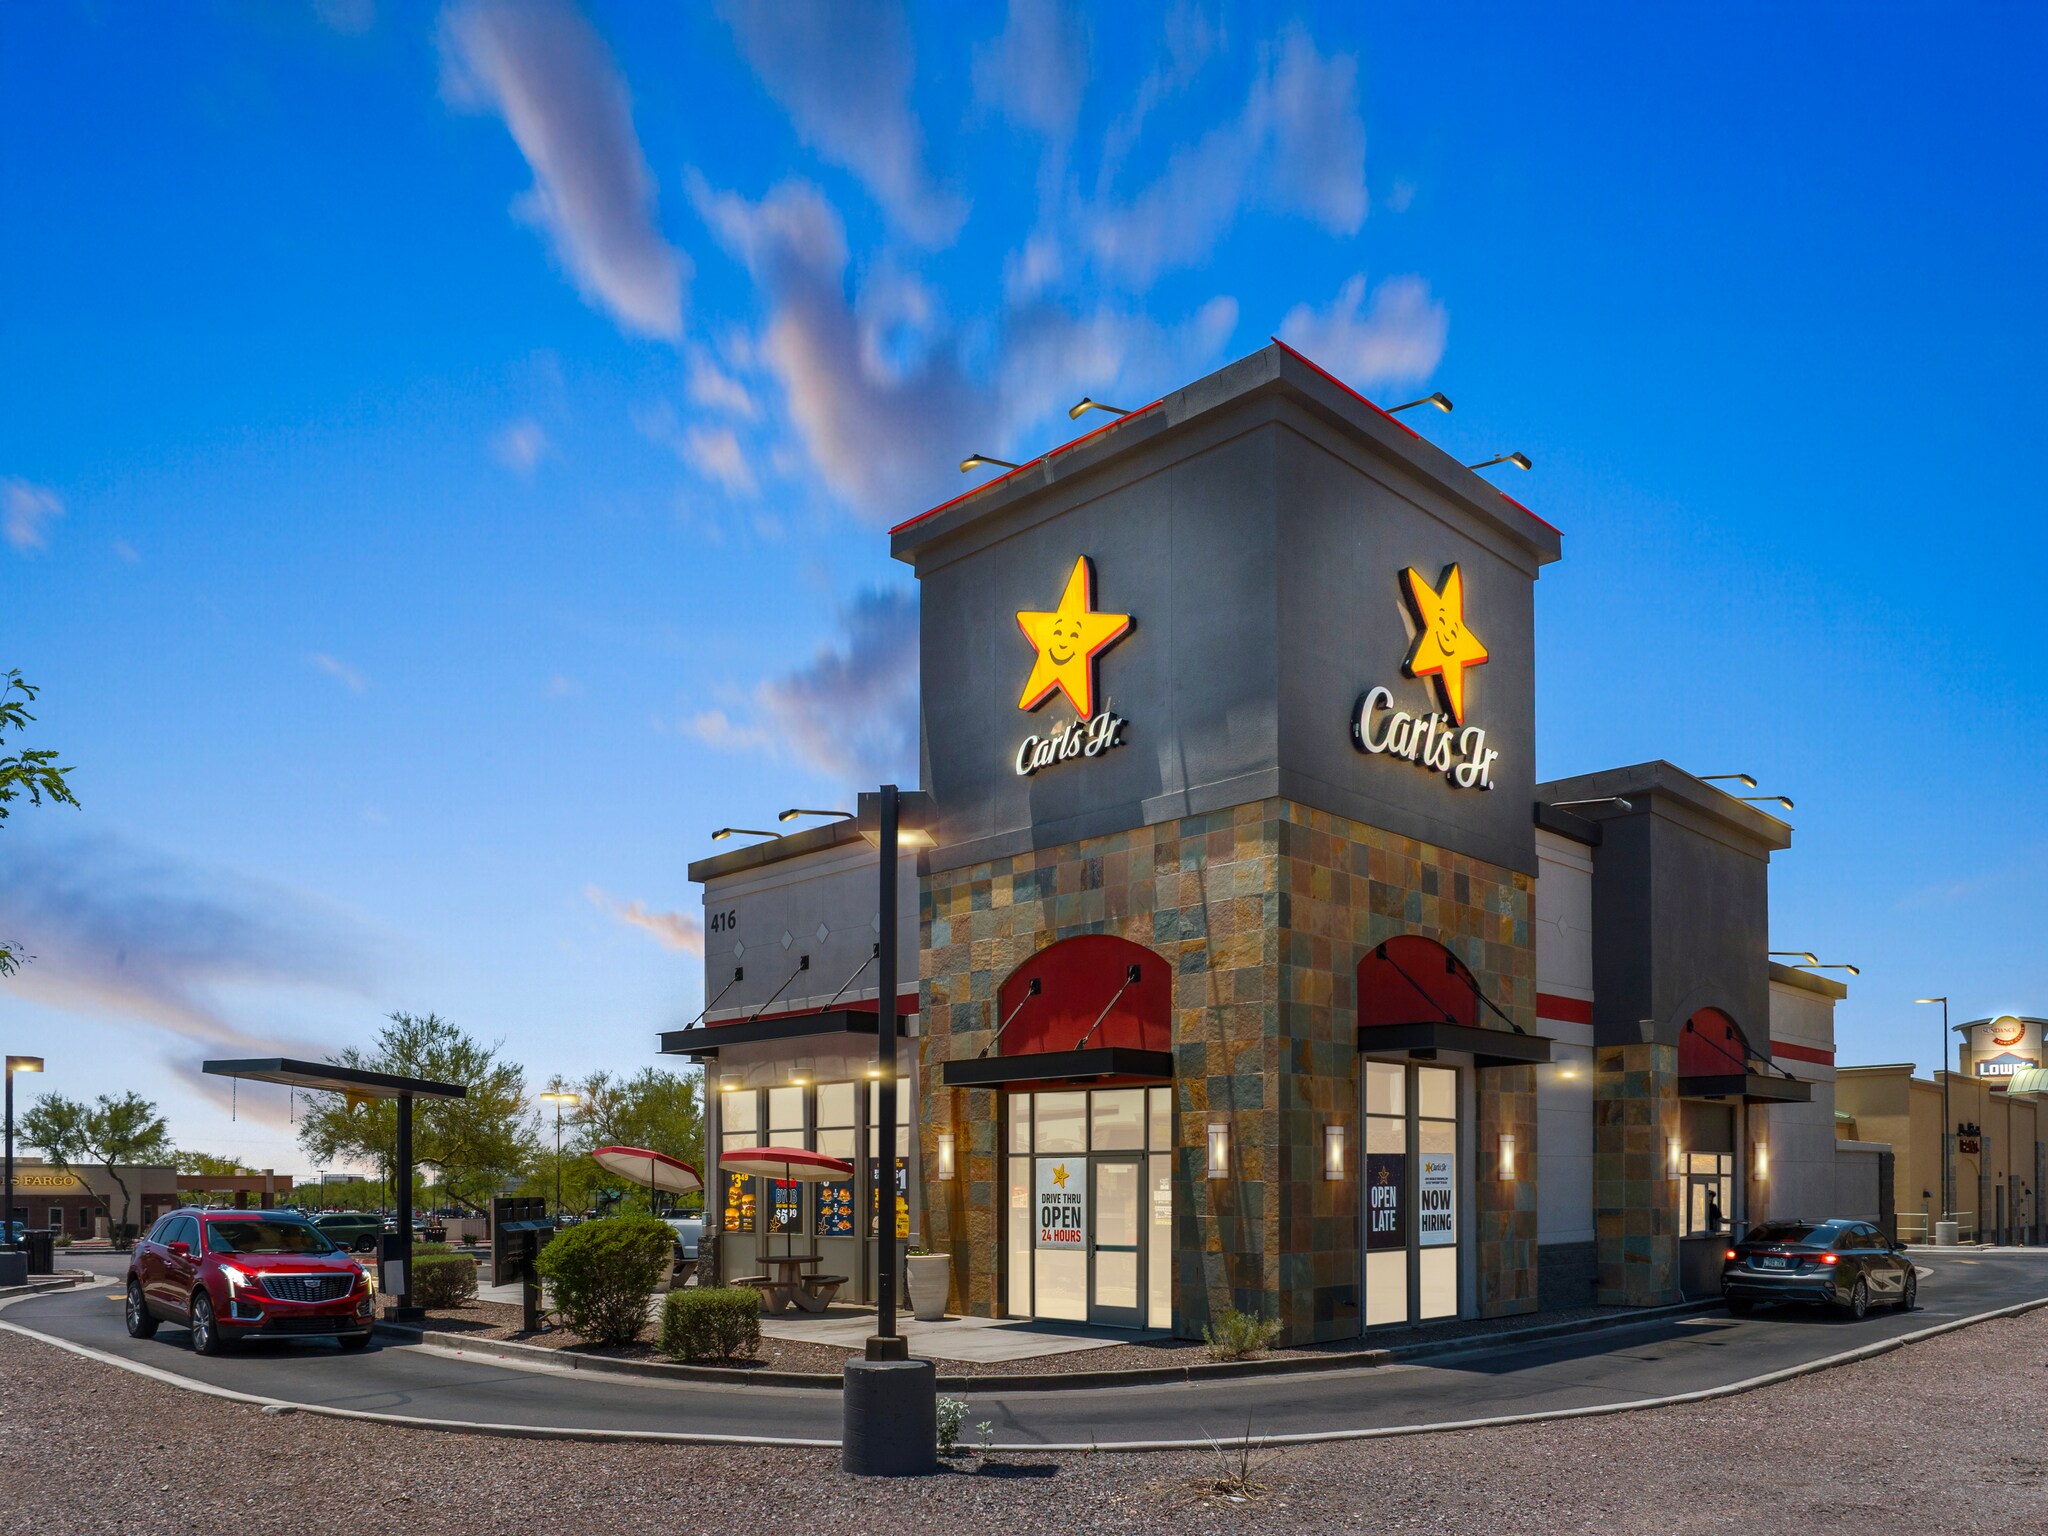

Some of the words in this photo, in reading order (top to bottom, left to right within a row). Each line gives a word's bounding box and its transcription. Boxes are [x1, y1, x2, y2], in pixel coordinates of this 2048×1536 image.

[1016, 721, 1084, 775] Carl's
[1084, 711, 1122, 757] Jr.
[1359, 686, 1454, 772] Carl's
[1455, 726, 1499, 790] Jr.
[710, 909, 737, 933] 416
[23, 1176, 75, 1186] FARGO
[1041, 1193, 1062, 1204] DRIVE
[1063, 1193, 1082, 1204] THRU
[1371, 1185, 1397, 1208] OPEN
[1421, 1189, 1451, 1211] NOW
[1041, 1206, 1082, 1229] OPEN
[1372, 1209, 1396, 1232] LATE
[1421, 1213, 1452, 1232] HIRING
[1041, 1229, 1052, 1242] 24
[1053, 1229, 1082, 1242] HOURS
